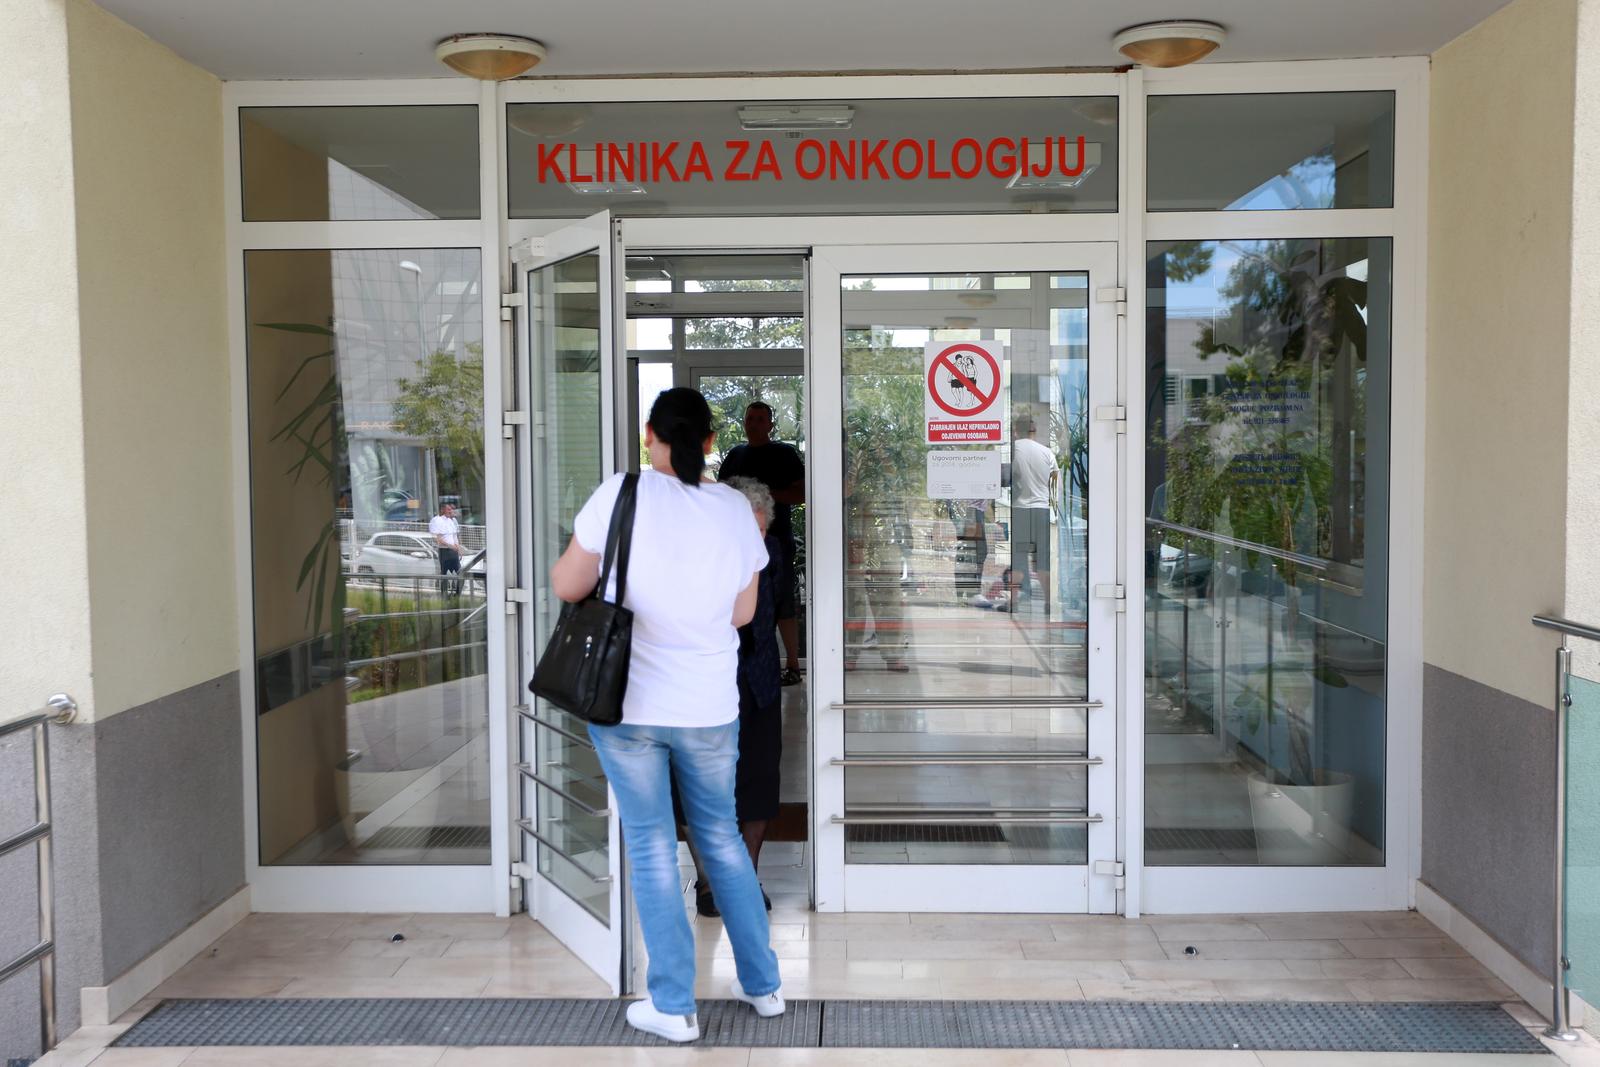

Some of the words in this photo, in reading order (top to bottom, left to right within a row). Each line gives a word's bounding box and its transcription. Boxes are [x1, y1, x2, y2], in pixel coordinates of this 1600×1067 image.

[538, 141, 713, 182] KLINIKA
[724, 140, 782, 181] ZA
[795, 136, 1085, 180] ONKOLOGIJU
